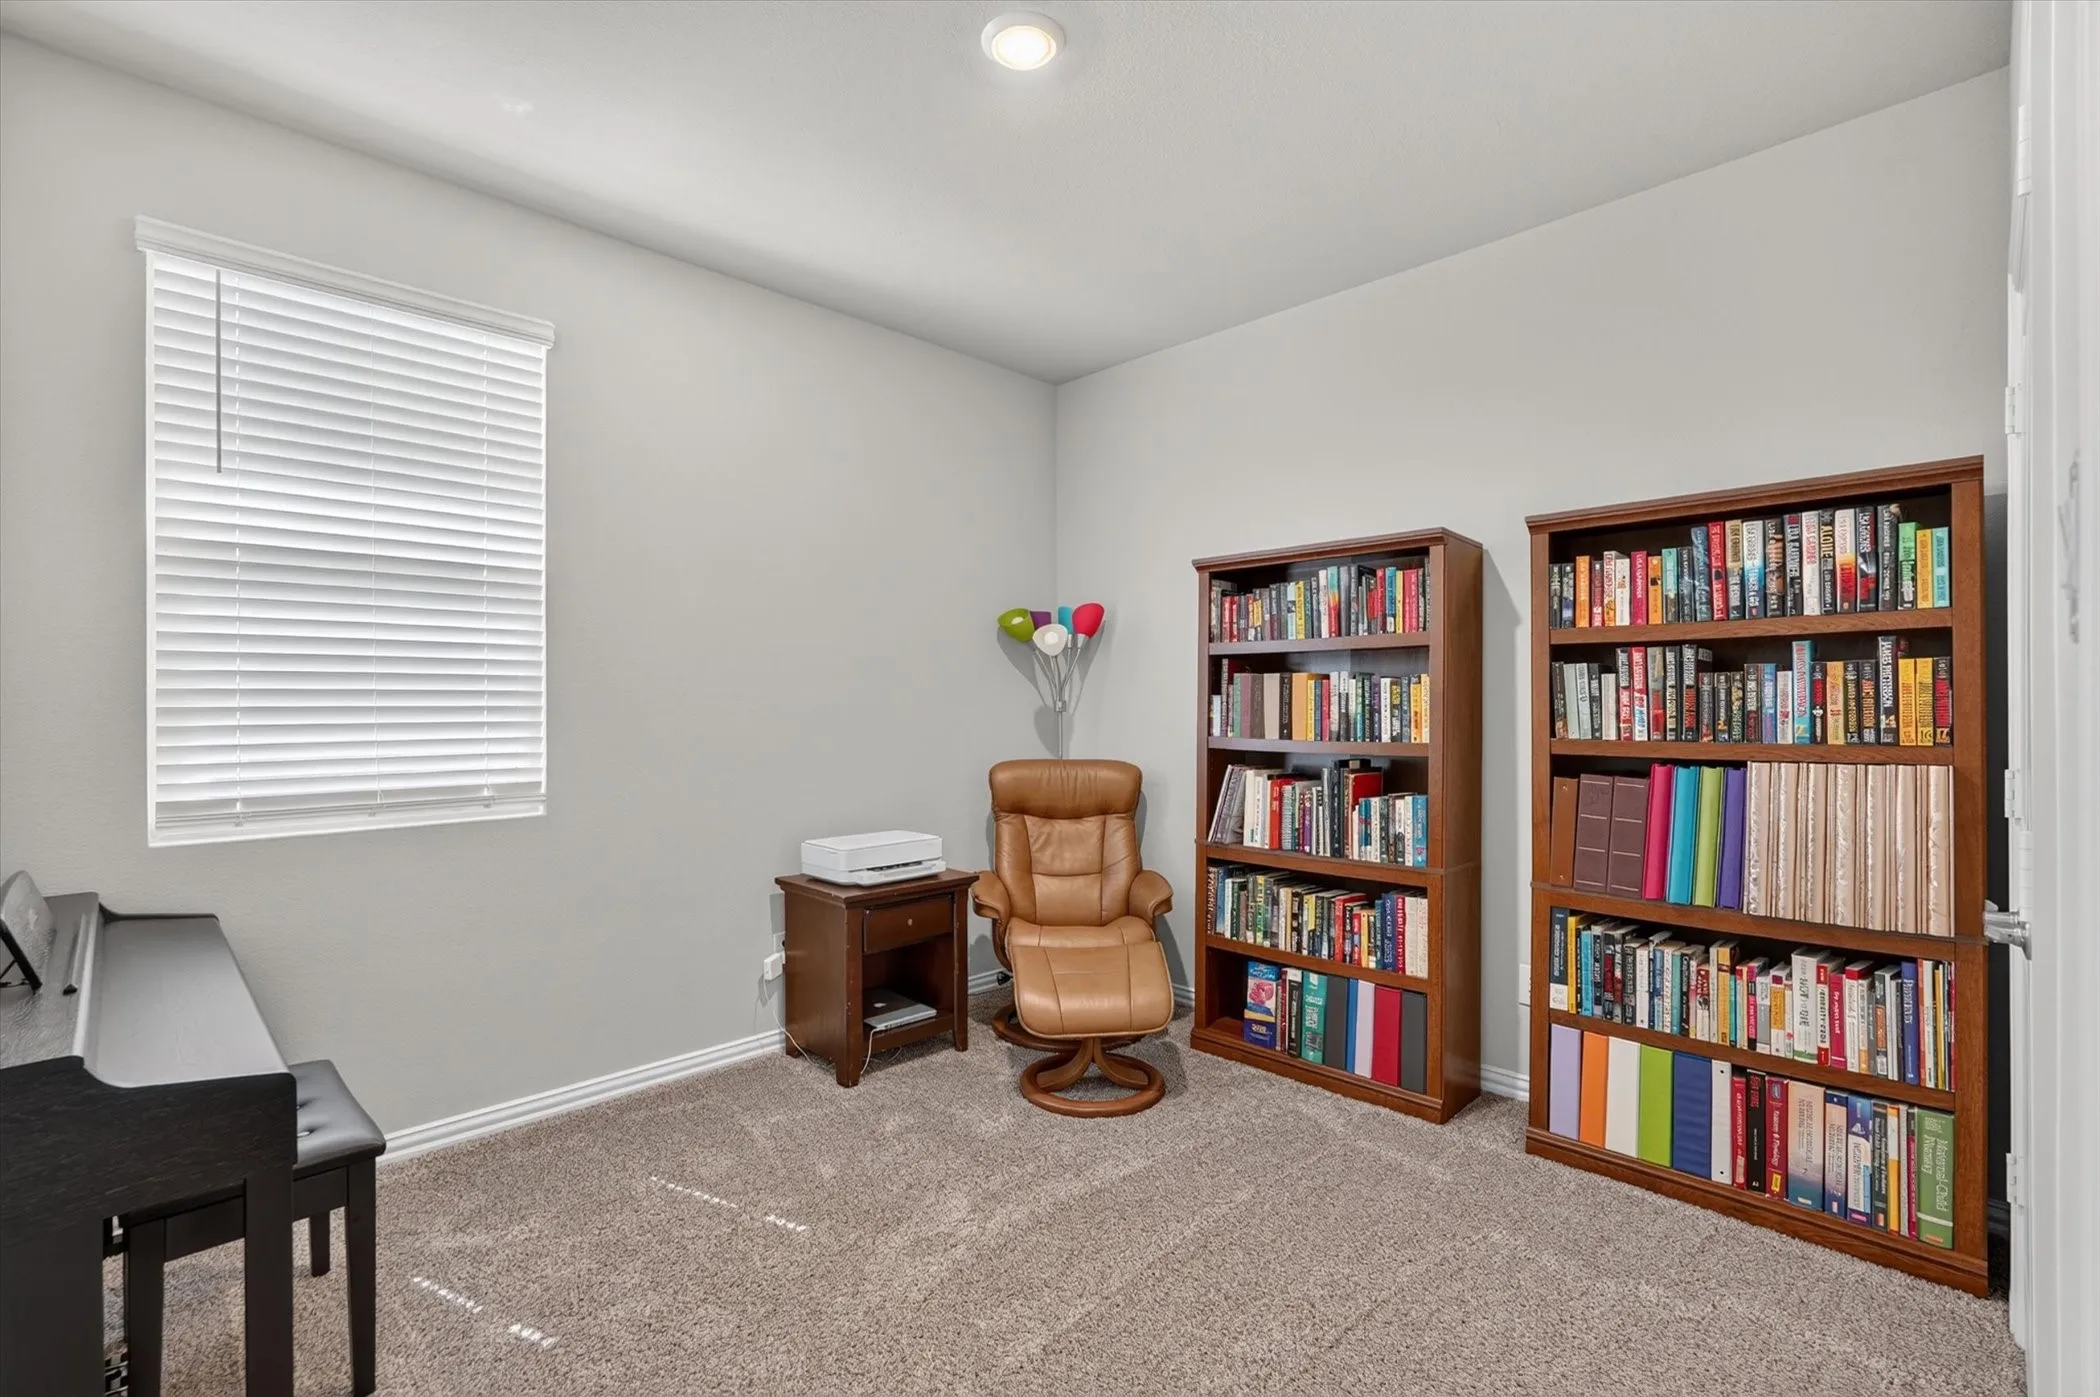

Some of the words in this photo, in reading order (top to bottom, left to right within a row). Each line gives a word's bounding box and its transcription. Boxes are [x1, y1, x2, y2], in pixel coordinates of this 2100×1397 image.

[1821, 525, 1833, 557] ALONE
[1881, 641, 1893, 664] JAMES
[1881, 666, 1893, 708] PATTERSON
[1799, 977, 1809, 1000] NOT
[1799, 1010, 1809, 1027] DIE
[1921, 1135, 1936, 1175] Nursing
[1935, 1139, 1949, 1212] Maternal-Child
